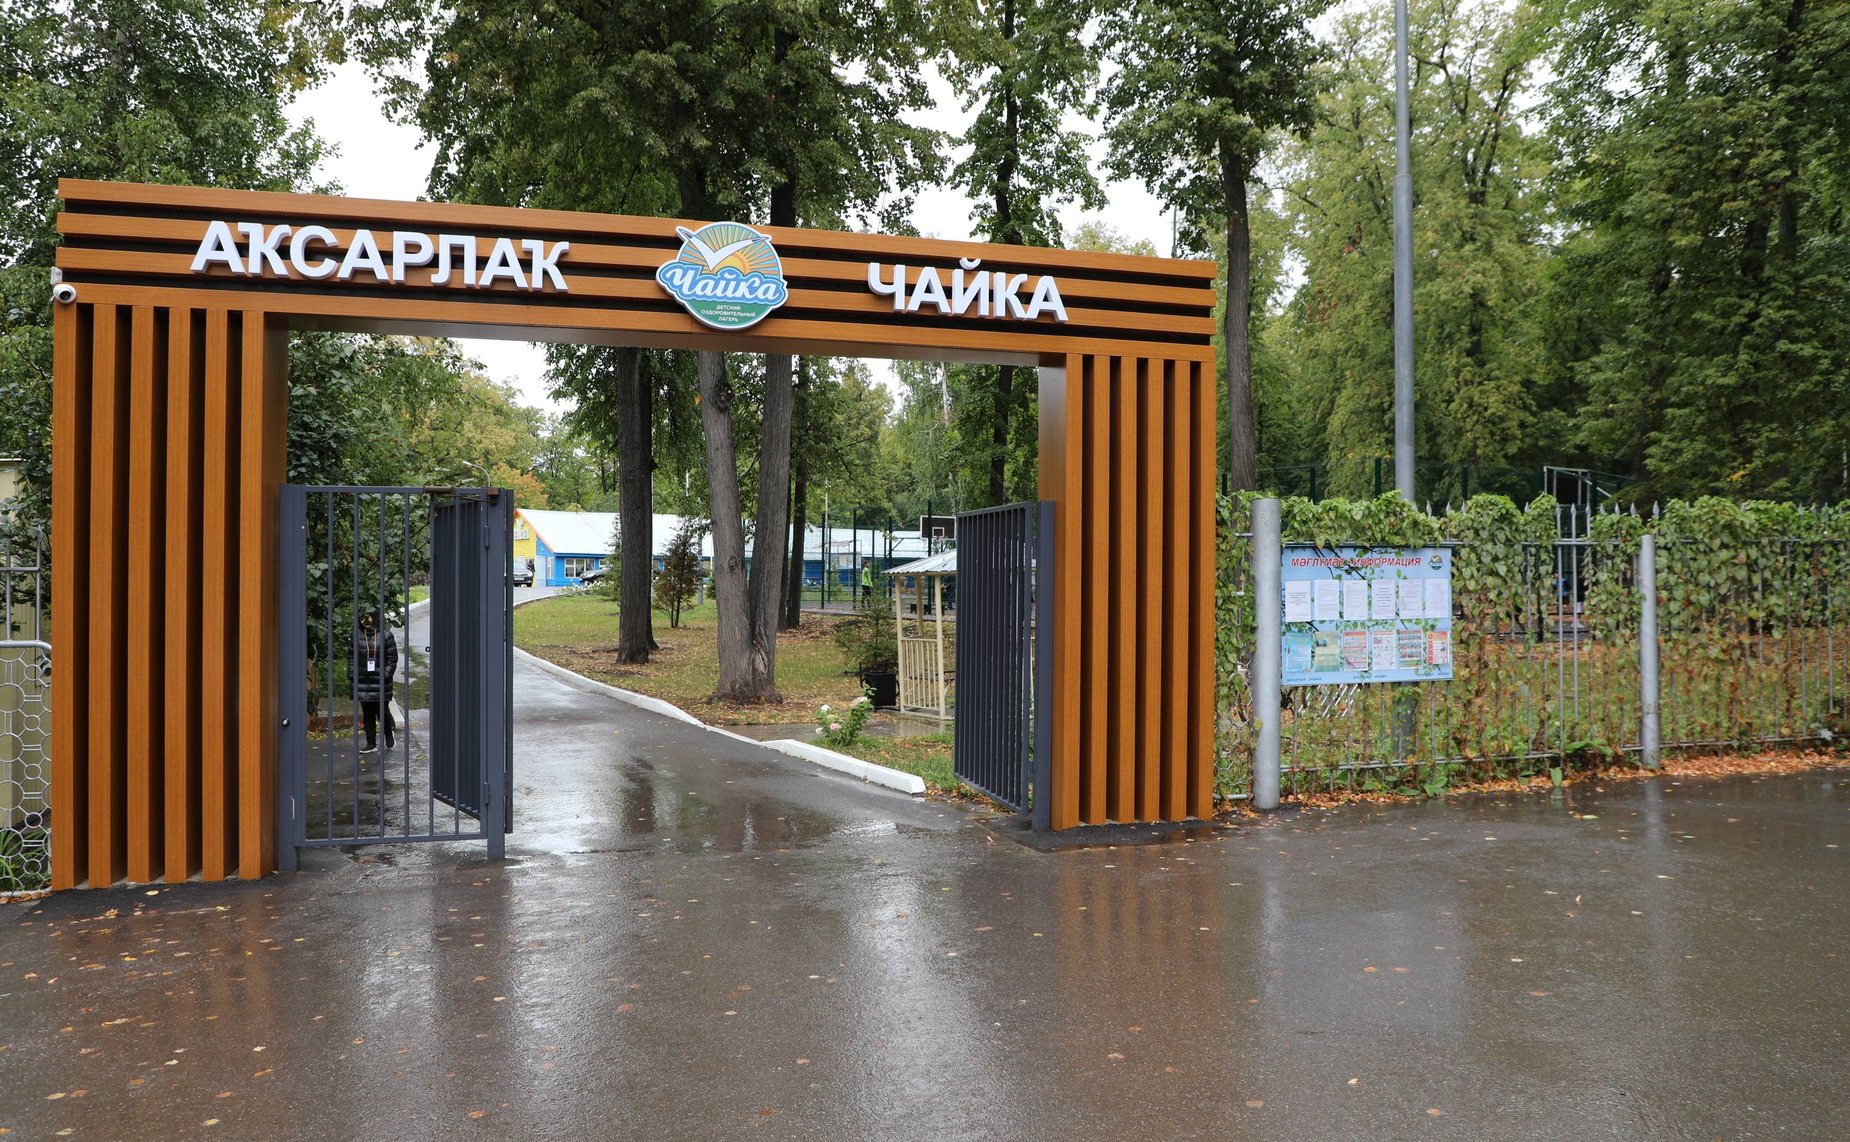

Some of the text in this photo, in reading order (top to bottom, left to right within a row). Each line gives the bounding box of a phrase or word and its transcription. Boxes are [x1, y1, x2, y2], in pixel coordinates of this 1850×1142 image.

[665, 269, 779, 299] Чайка
[867, 257, 1069, 322] ЧАЙКА
[1353, 557, 1421, 567] ИНФОРМАЦИЯ
